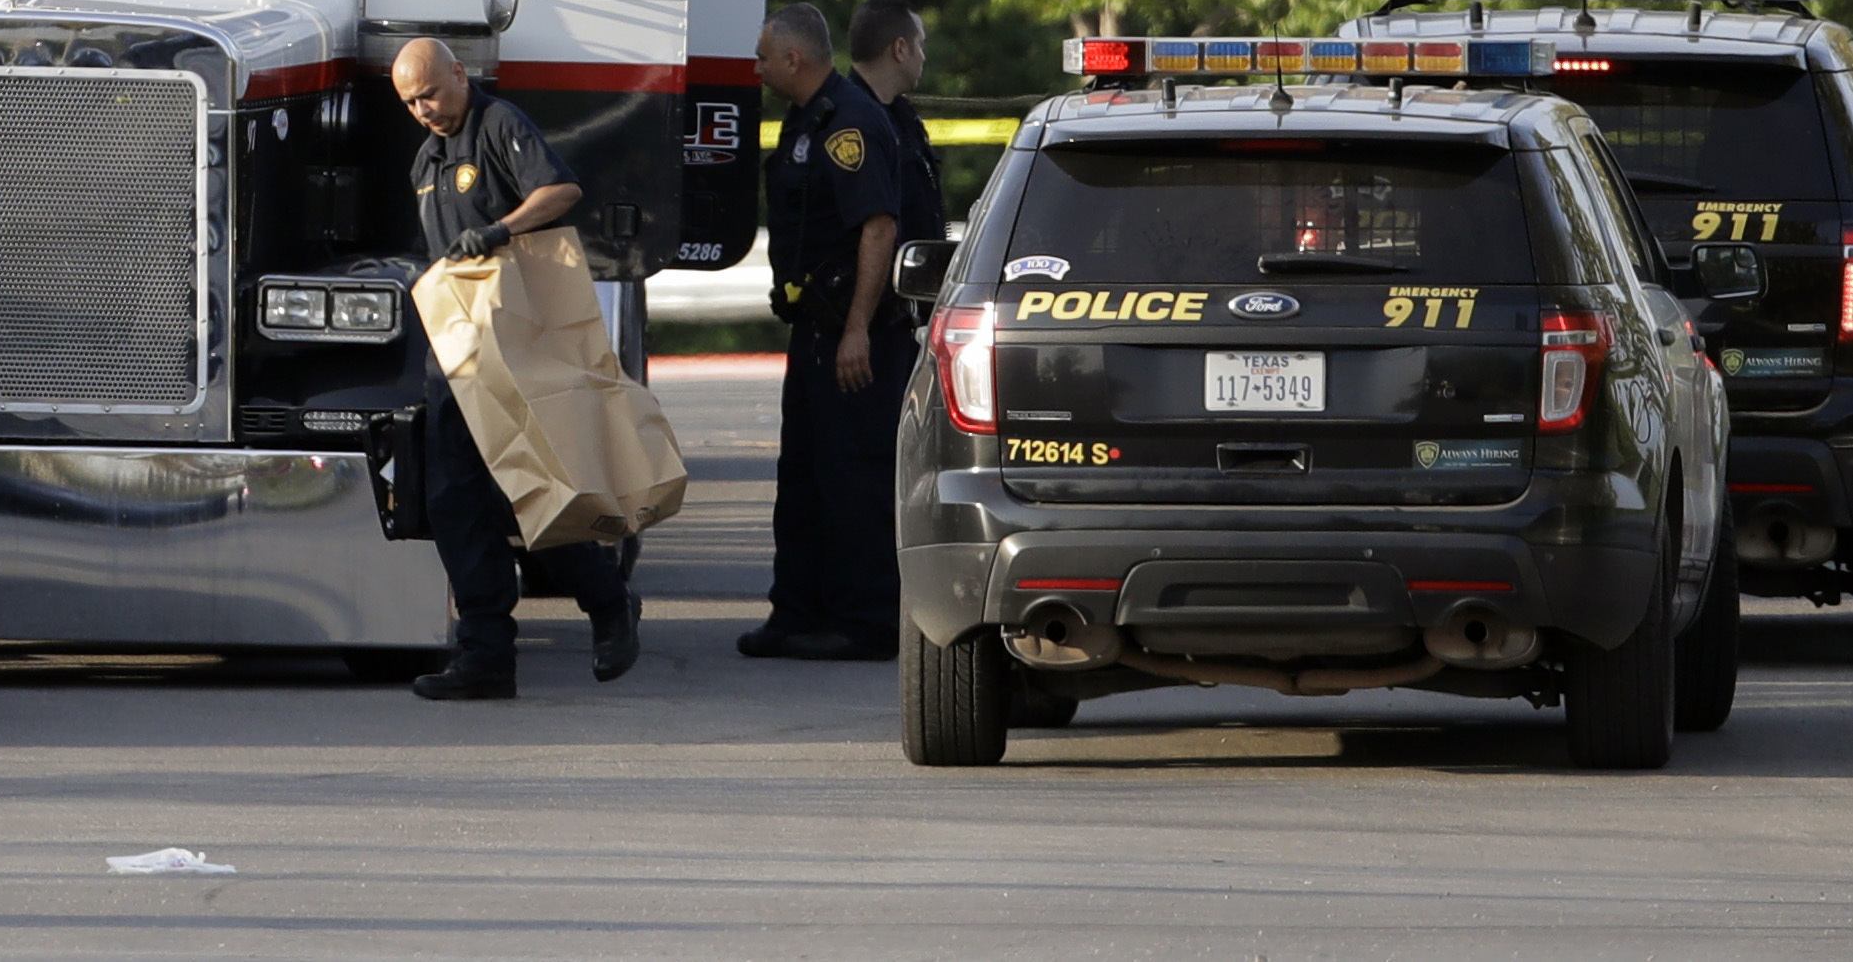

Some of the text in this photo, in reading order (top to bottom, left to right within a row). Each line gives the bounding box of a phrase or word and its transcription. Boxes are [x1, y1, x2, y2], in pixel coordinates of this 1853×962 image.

[1697, 202, 1783, 212] EMERGENCY
[1692, 212, 1779, 241] 911
[678, 243, 722, 261] 5286
[1027, 259, 1050, 269] 100
[1389, 287, 1479, 298] EMERGENCY
[1016, 291, 1209, 321] POLICE
[1245, 296, 1283, 312] Ford
[1383, 297, 1475, 328] 911
[1243, 355, 1290, 367] TEXAS
[1007, 439, 1109, 464] 712614 S
[1440, 448, 1519, 458] ALWAYS HIRING
